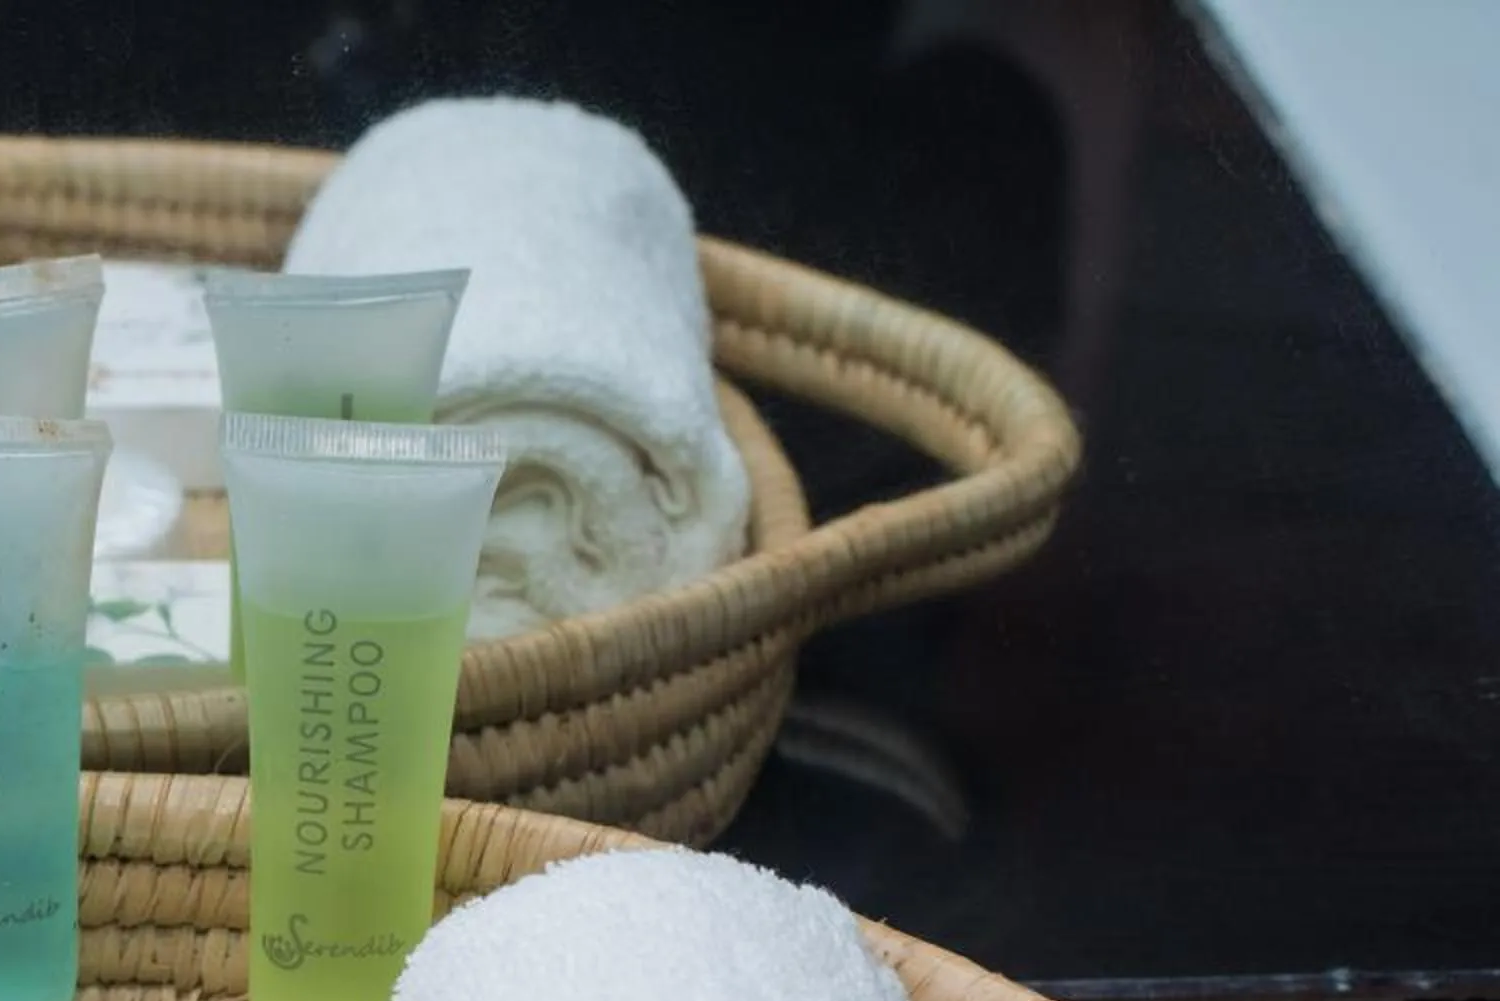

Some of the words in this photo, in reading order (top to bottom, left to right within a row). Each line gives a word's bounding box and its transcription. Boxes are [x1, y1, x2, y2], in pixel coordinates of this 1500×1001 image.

[295, 607, 337, 876] NOURISHING
[341, 640, 385, 852] SHAMPOO
[262, 913, 406, 971] Serendib
